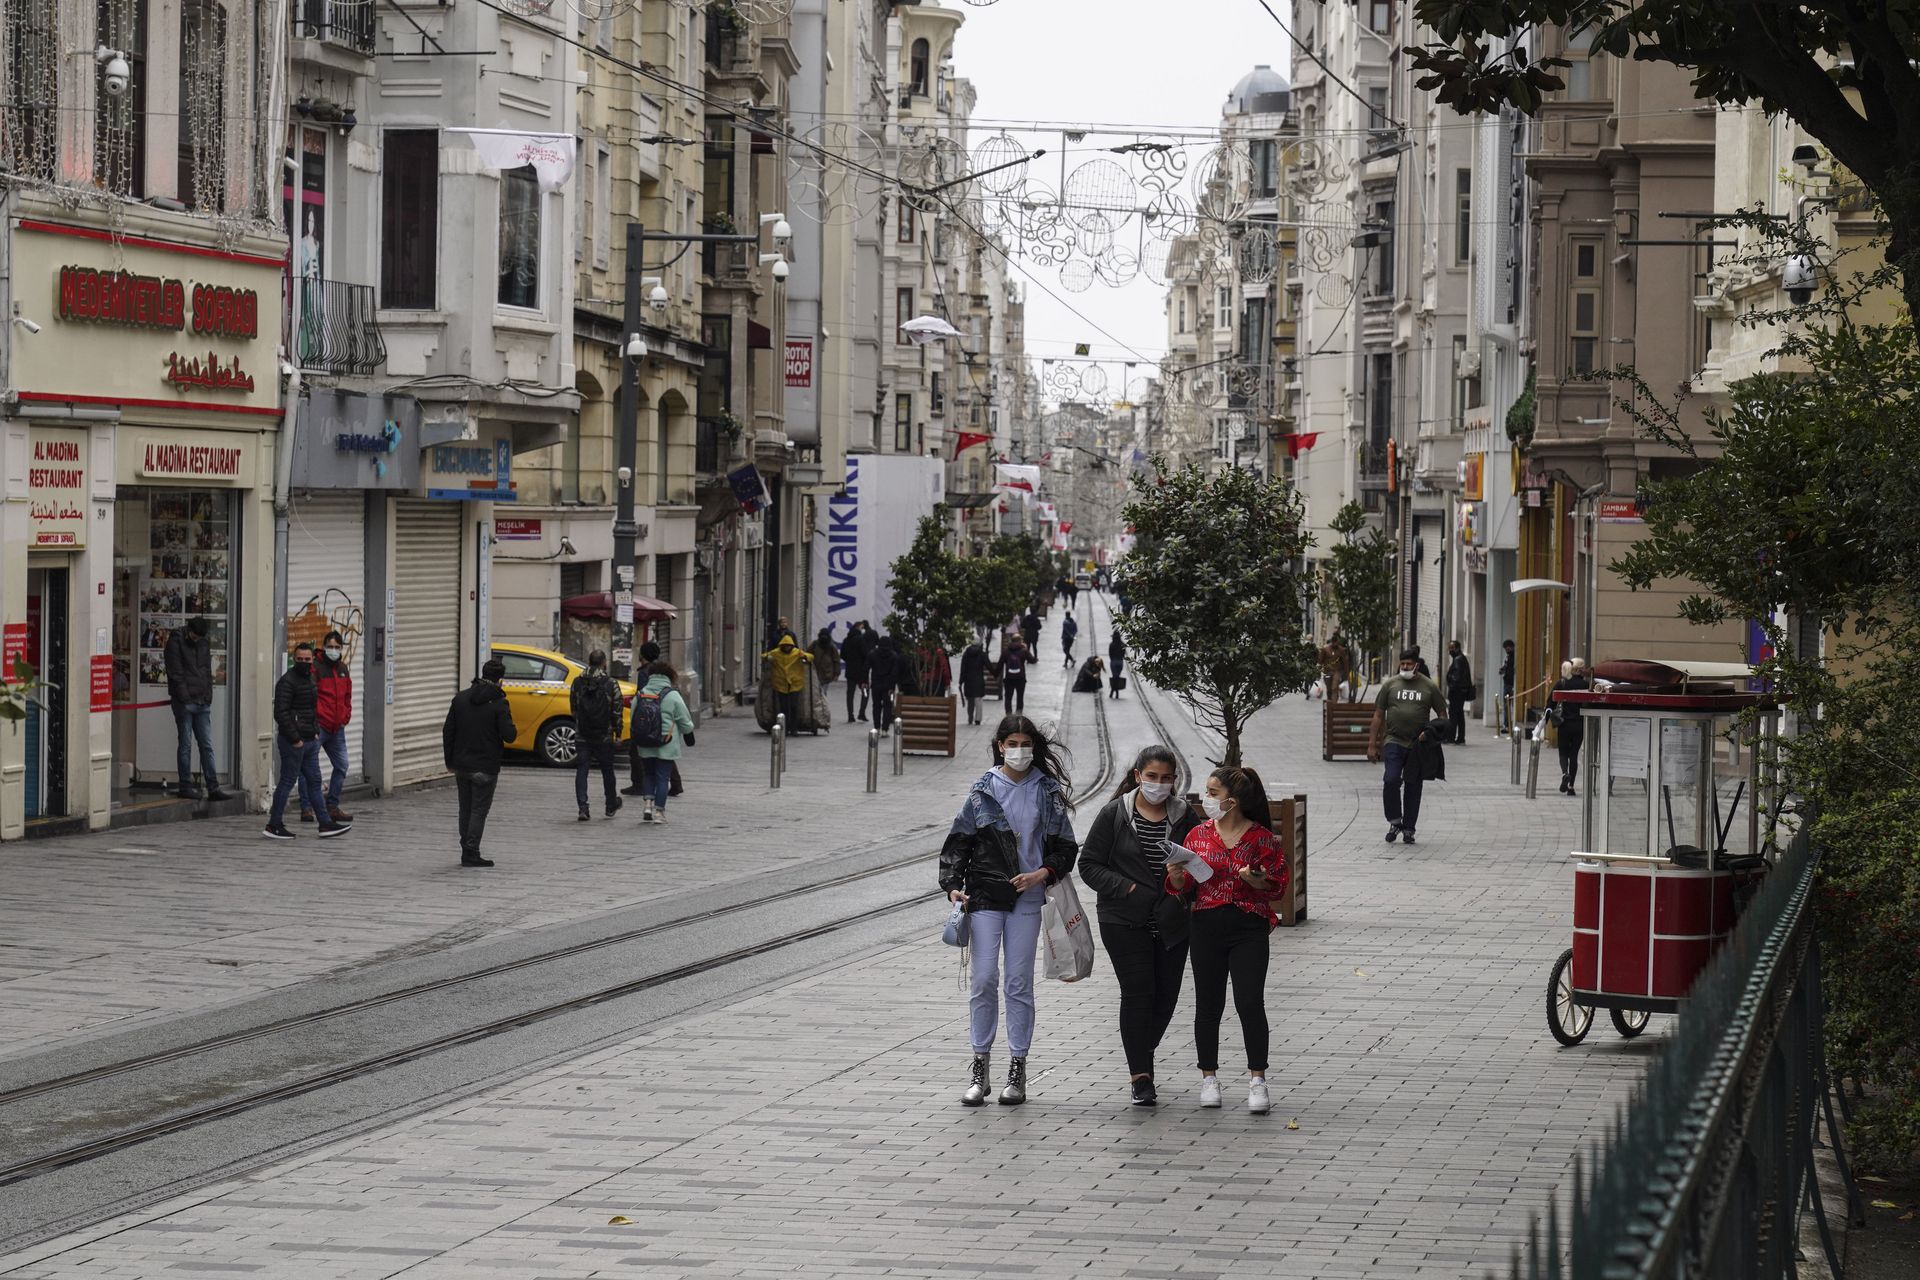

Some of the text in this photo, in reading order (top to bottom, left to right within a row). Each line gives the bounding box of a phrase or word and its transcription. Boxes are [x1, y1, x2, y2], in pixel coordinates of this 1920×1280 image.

[193, 282, 257, 339] SOFRASI
[785, 344, 809, 360] ROTİK
[786, 361, 809, 375] HOP
[34, 441, 44, 460] AL
[144, 444, 154, 471] AL
[189, 446, 241, 475] RESTAURANT
[30, 469, 83, 489] RESTAURANT
[497, 521, 526, 529] MEŞELİK
[1397, 690, 1421, 701] ICON
